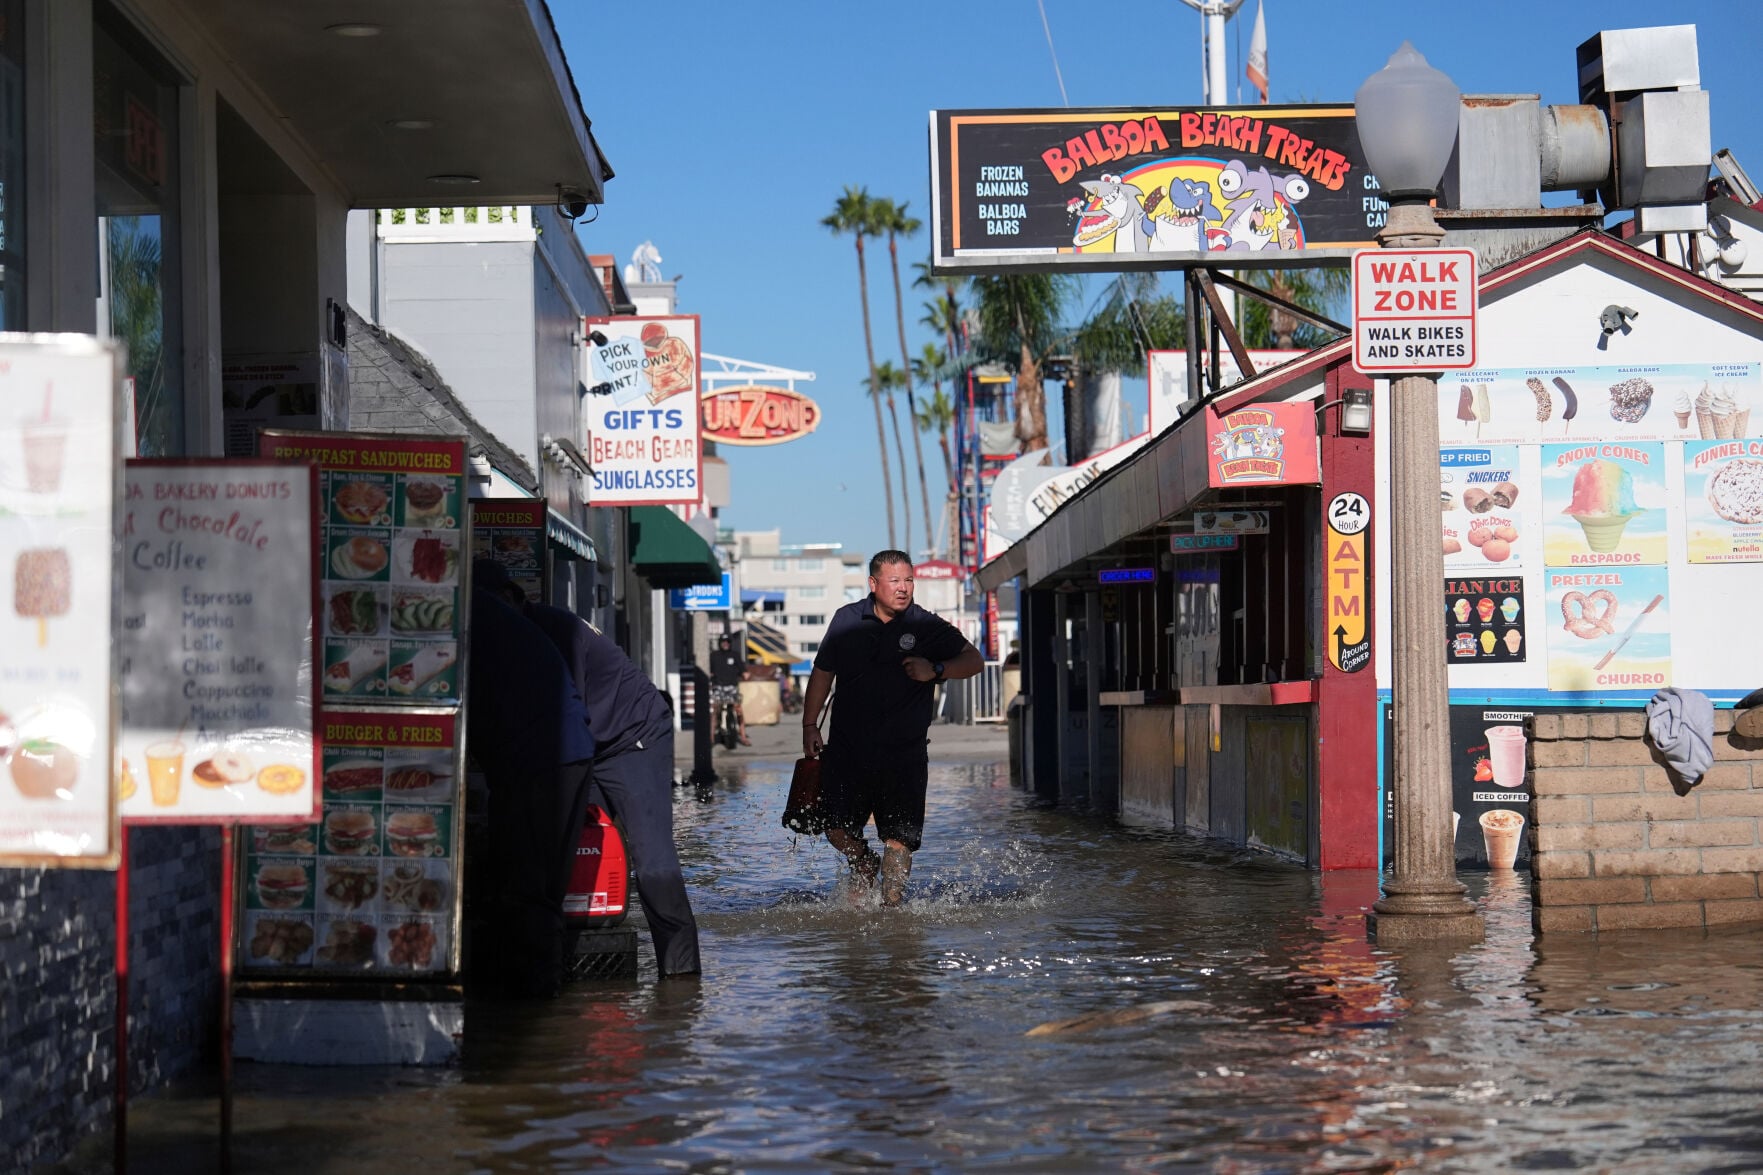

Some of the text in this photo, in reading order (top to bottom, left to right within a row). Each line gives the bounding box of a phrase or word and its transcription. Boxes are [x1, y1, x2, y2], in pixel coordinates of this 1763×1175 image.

[1041, 112, 1351, 192] BALBOA BEACH TREATS
[980, 166, 1023, 182] FROZEN
[976, 181, 1029, 198] BANANAS
[978, 204, 1027, 221] BALBOA
[986, 220, 1020, 236] BARS
[1370, 261, 1460, 284] WALK
[1374, 289, 1457, 312] ZONE
[1368, 326, 1464, 341] WALK BIKES
[599, 343, 632, 363] PICK
[1367, 344, 1466, 358] AND SKATES
[607, 353, 670, 373] YOUR OWN
[592, 371, 639, 398] PRINT!
[603, 409, 683, 430] GIFTS
[1227, 412, 1269, 429] BALBOA
[360, 450, 452, 469] SANDWICHES
[593, 435, 694, 464] BEACH GEAR
[1458, 453, 1490, 462] FRIED
[1557, 445, 1650, 468] SNOW CONES
[1695, 442, 1746, 469] FUNNEL
[593, 468, 696, 490] SUNGLASSES
[1467, 471, 1511, 483] SNICKERS
[155, 481, 219, 501] BAKERY
[225, 480, 291, 500] DONUTS
[1032, 480, 1067, 517] FUN
[1334, 498, 1363, 518] 24
[157, 506, 270, 551] Chocolate
[1338, 519, 1359, 531] HOUR
[132, 540, 207, 571] Coffee
[1571, 552, 1641, 564] RASPADOS
[1732, 544, 1760, 552] nutella
[1333, 540, 1360, 617] ATM
[1487, 579, 1521, 594] ICE
[1552, 574, 1623, 587] PRETZEL
[1341, 641, 1369, 662] AROUND
[1342, 651, 1370, 672] CORNER
[1596, 672, 1665, 686] CHURRO
[326, 724, 443, 743] BURGER & FRIES
